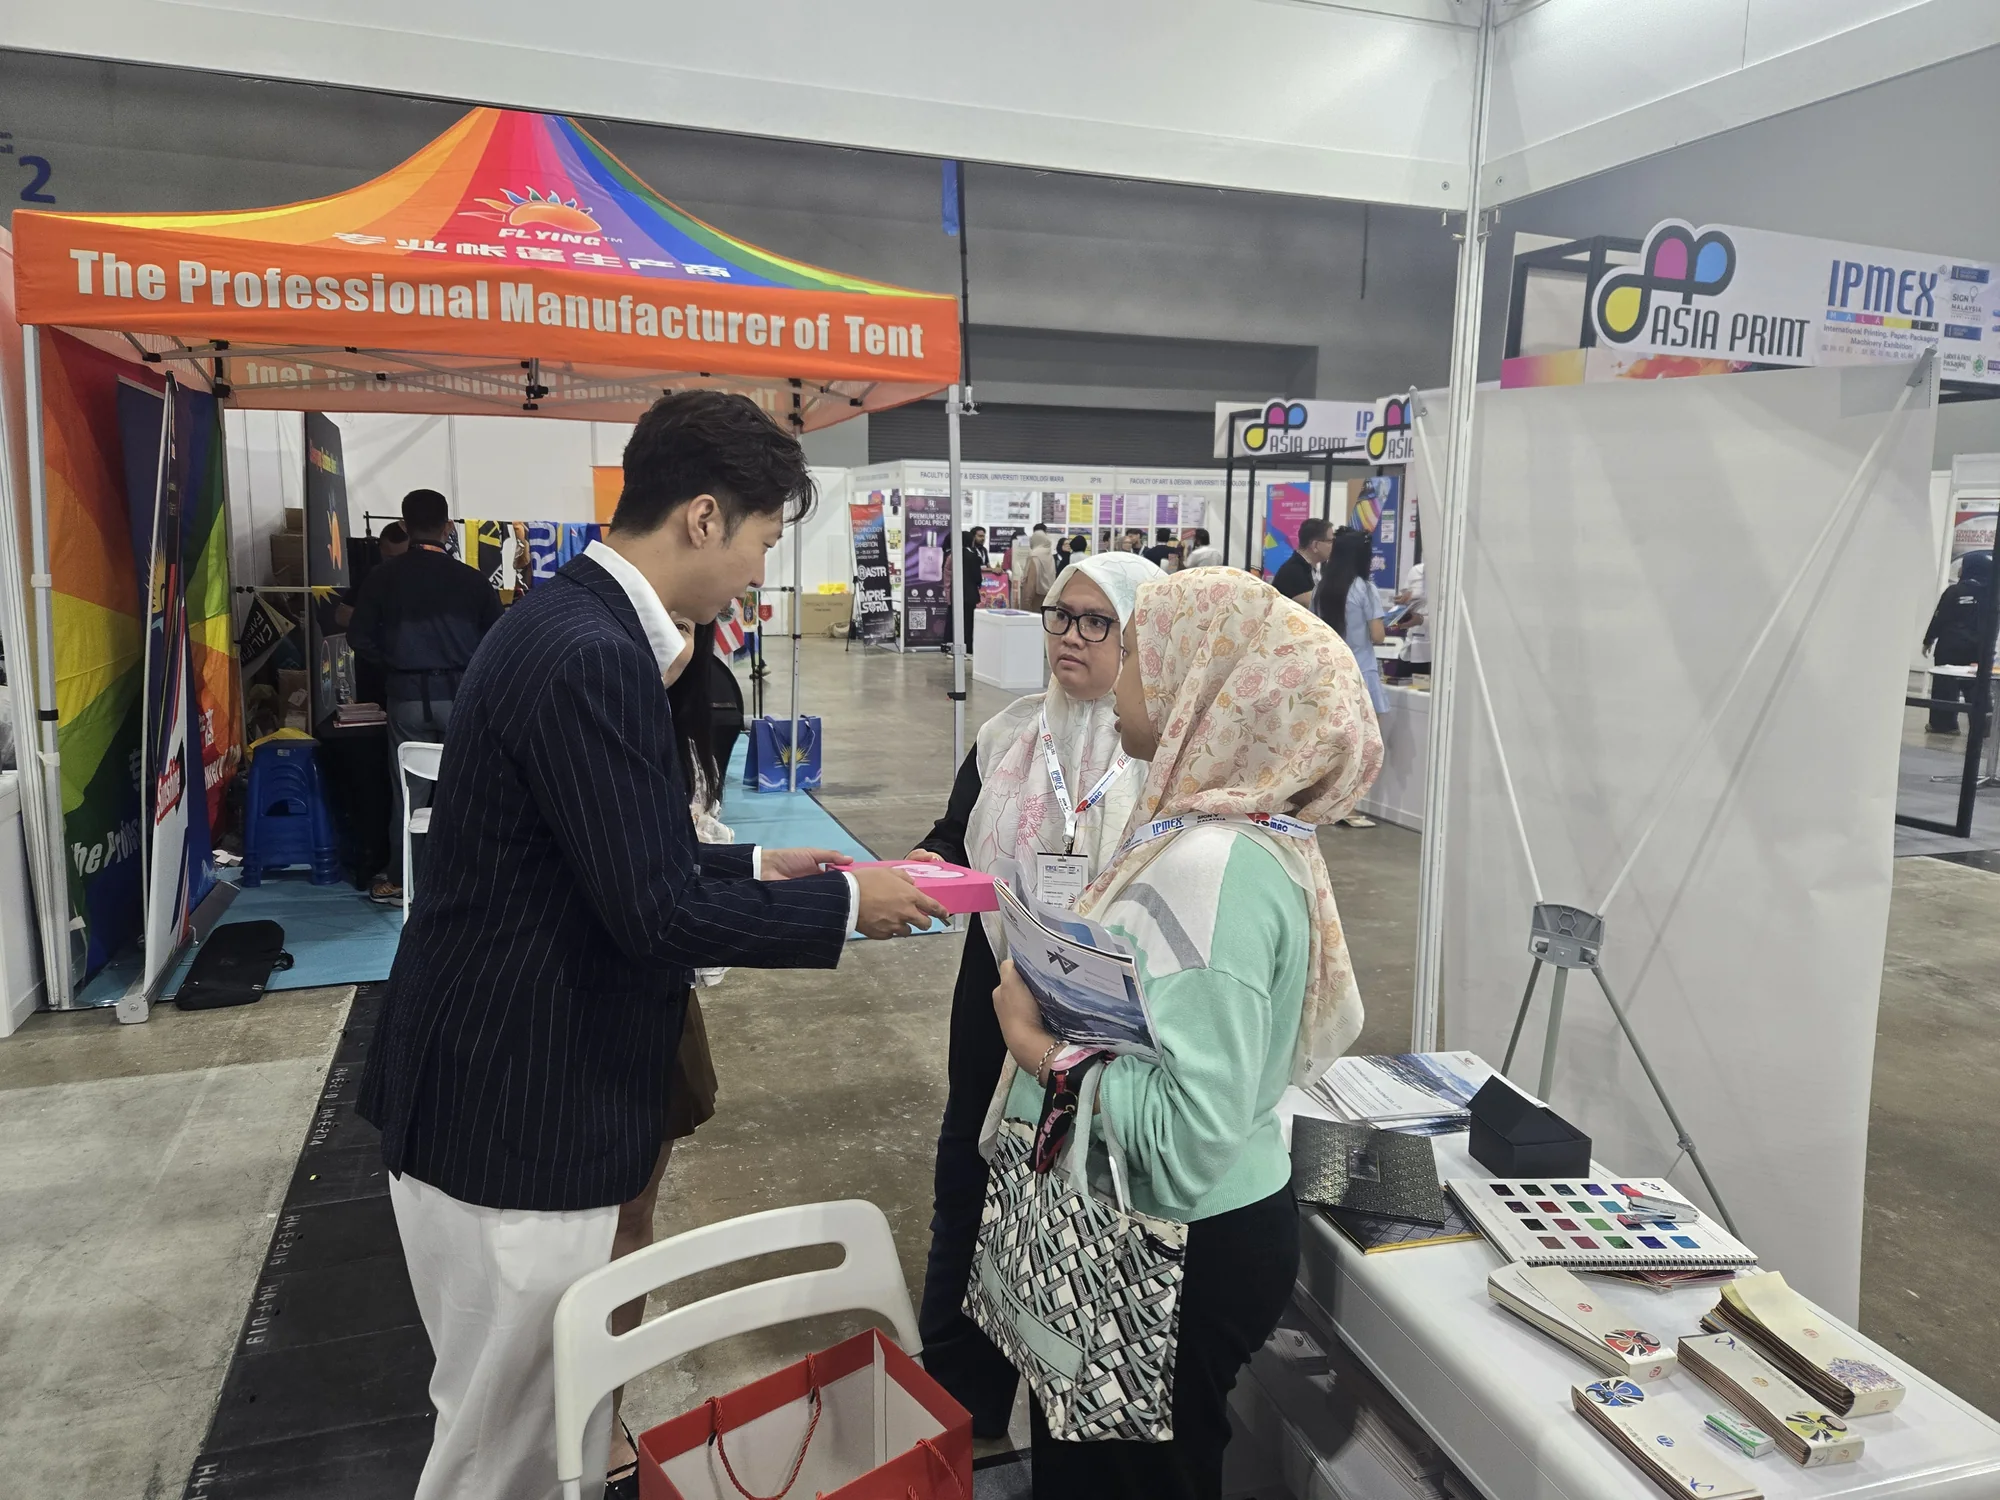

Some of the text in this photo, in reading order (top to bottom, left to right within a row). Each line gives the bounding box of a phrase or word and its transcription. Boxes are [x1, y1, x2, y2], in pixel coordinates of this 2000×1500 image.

[19, 155, 56, 204] 2
[1827, 259, 1939, 318] IPMEX
[69, 249, 925, 360] The Professional Manufacturer of Tent
[1650, 303, 1811, 358] ASIA PRINT
[1823, 324, 1863, 336] International
[1910, 333, 1939, 344] Packaging
[1828, 311, 1938, 331] MALAIA
[1850, 337, 1913, 350] Machinery Exhibition
[1269, 434, 1348, 455] ASIA PRINT
[920, 471, 944, 479] FACULTY
[909, 512, 951, 521] PREMIUM SCEN
[1151, 816, 1184, 835] IPMEX
[310, 1107, 335, 1147] H4-E-204
[269, 1213, 301, 1267] H4-E-206
[245, 1283, 280, 1346] H4-F-019
